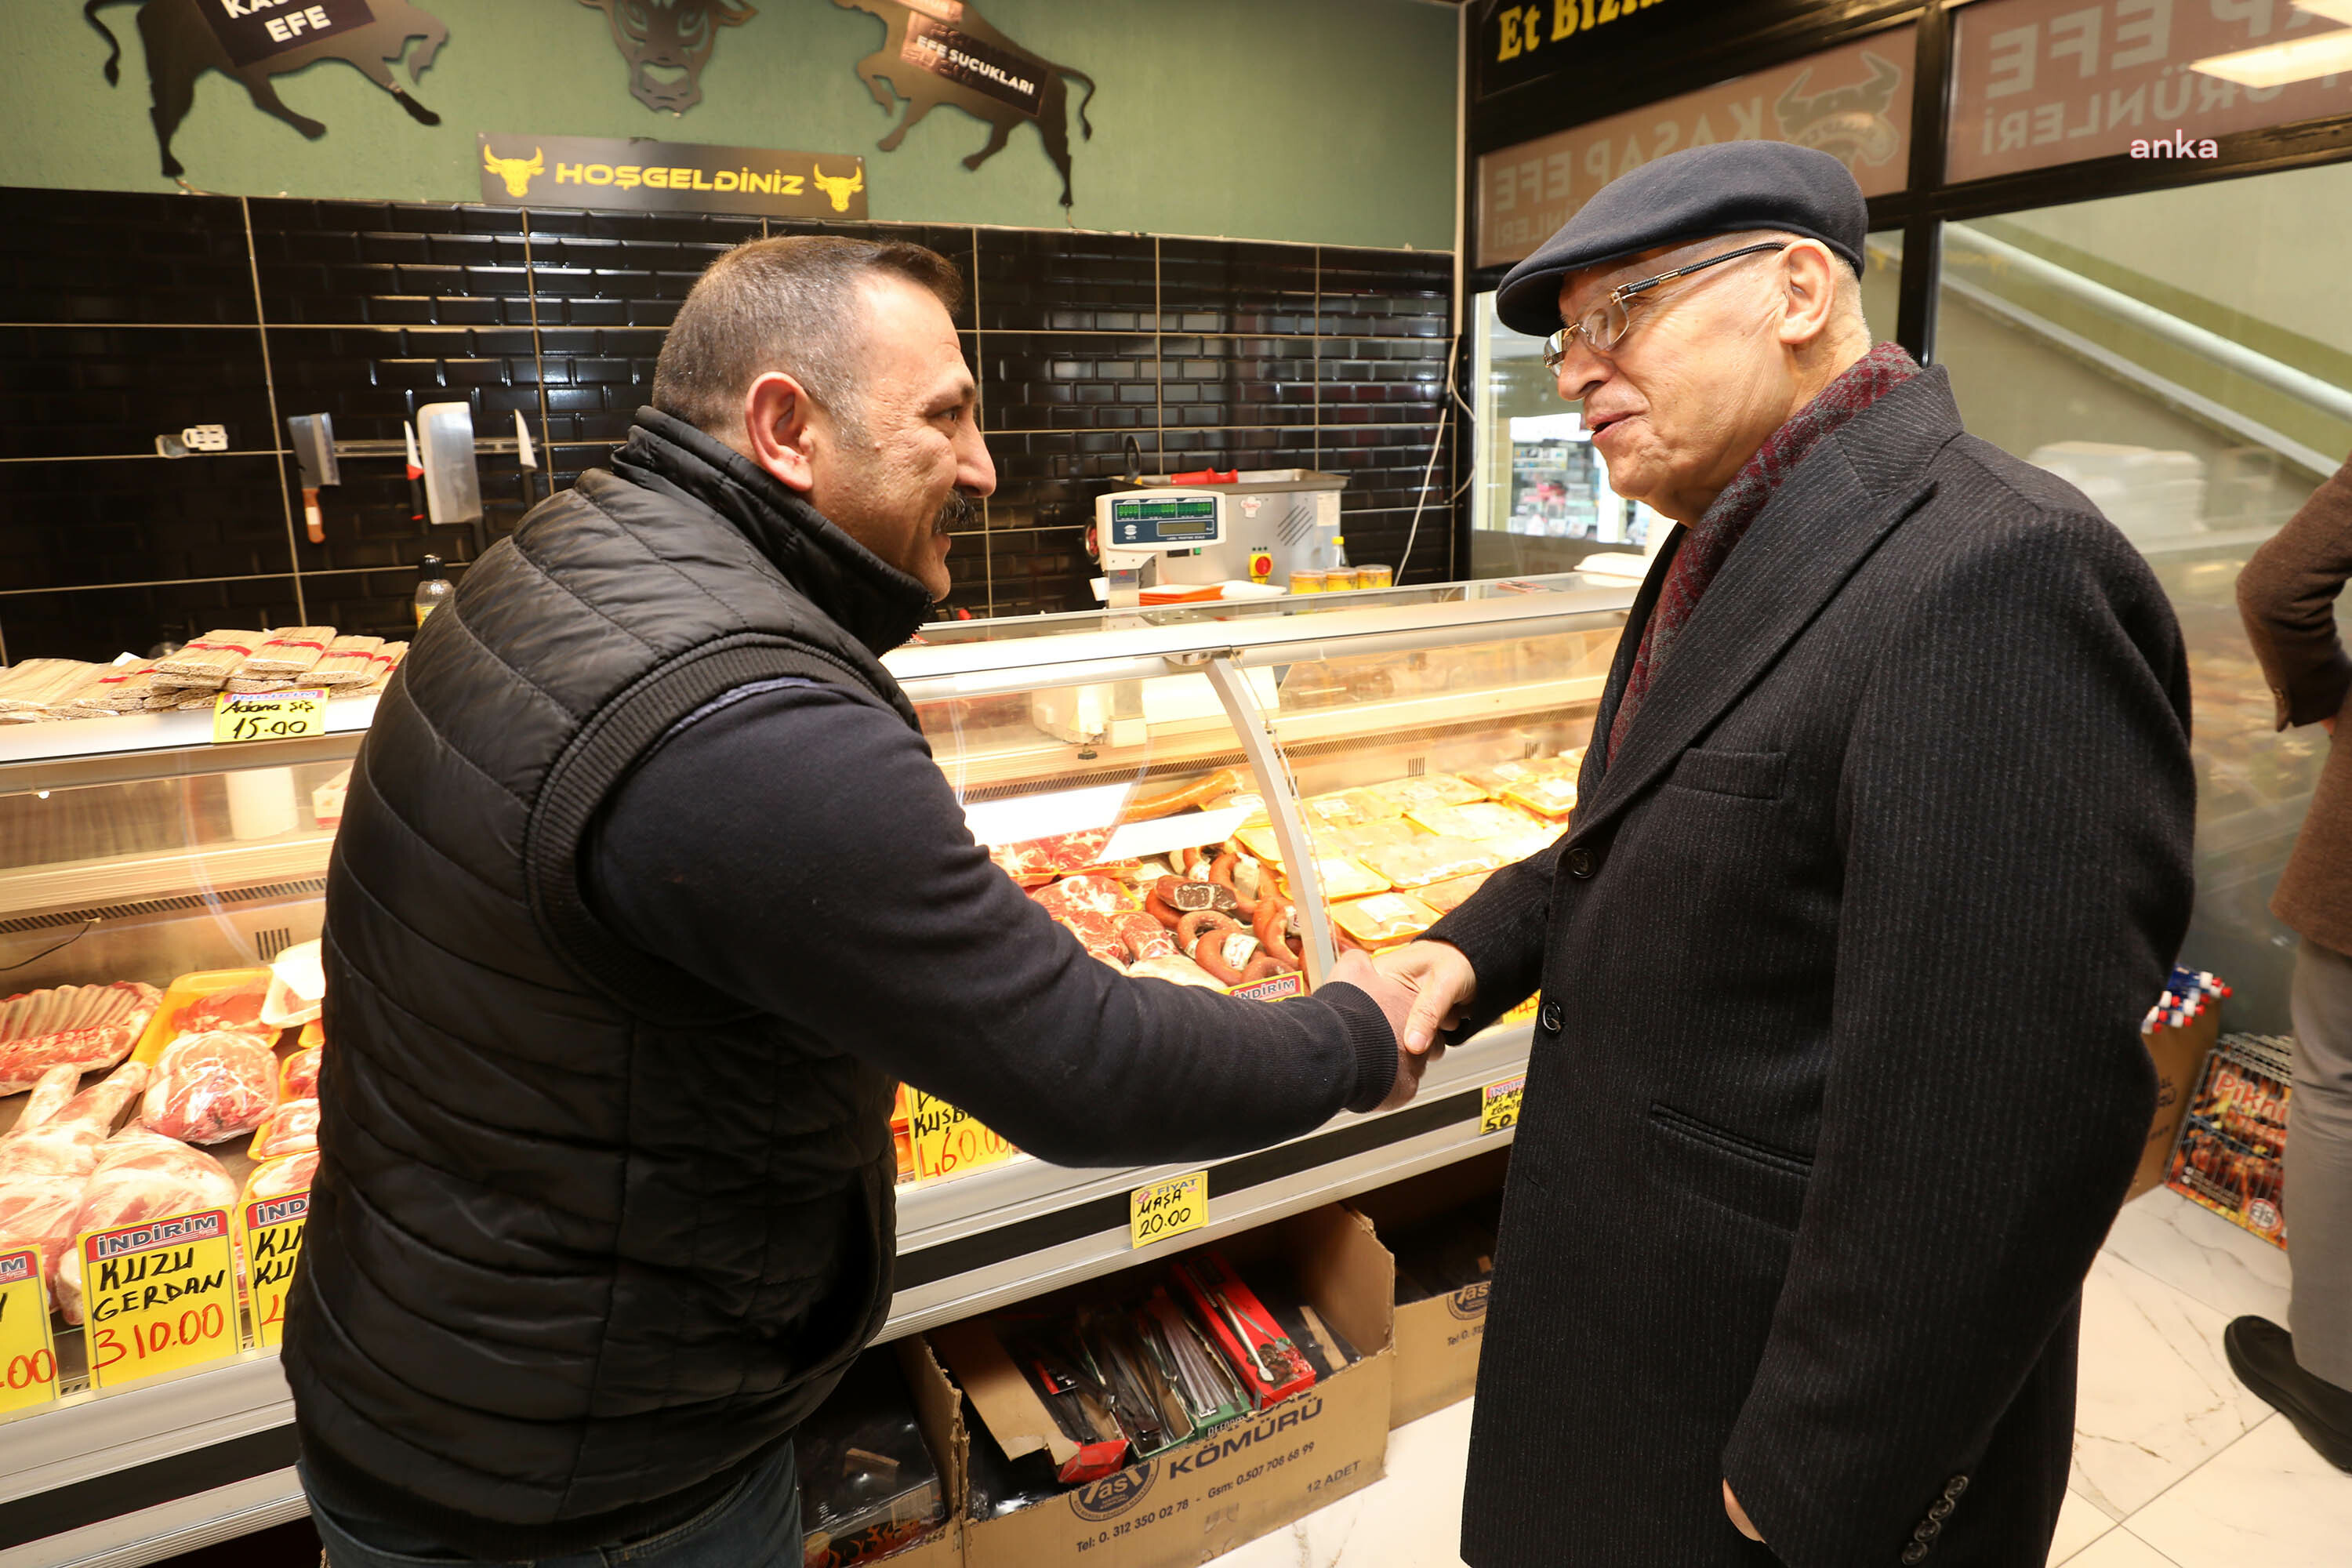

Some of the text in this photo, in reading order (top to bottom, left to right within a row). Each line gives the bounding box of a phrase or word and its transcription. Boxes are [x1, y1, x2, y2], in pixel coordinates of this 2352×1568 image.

[264, 5, 332, 42] EFE
[1497, 4, 1541, 63] Et
[916, 34, 1035, 96] EFE SUCUKLARI
[555, 162, 804, 195] HOŞGELDİNİZ
[233, 717, 307, 739] 15.00
[1137, 1189, 1181, 1217] MAŞA
[1138, 1207, 1191, 1238] 20.00
[97, 1214, 218, 1257] İNDİRİM
[99, 1248, 194, 1292] KUZU
[93, 1269, 226, 1323] GERDAN
[93, 1303, 223, 1370] 310.00
[1169, 1396, 1323, 1479] KÖMÜRÜ
[1076, 1537, 1096, 1552] Tel:
[1112, 1522, 1131, 1537] 312
[1134, 1512, 1155, 1529] 350
[1159, 1505, 1173, 1519] 02
[1177, 1499, 1189, 1512] 78
[1207, 1481, 1233, 1498] Gsm:
[1267, 1456, 1285, 1472] 708
[1287, 1449, 1300, 1462] 68
[1302, 1441, 1314, 1455] 99
[1306, 1460, 1361, 1493] 12 ADET
